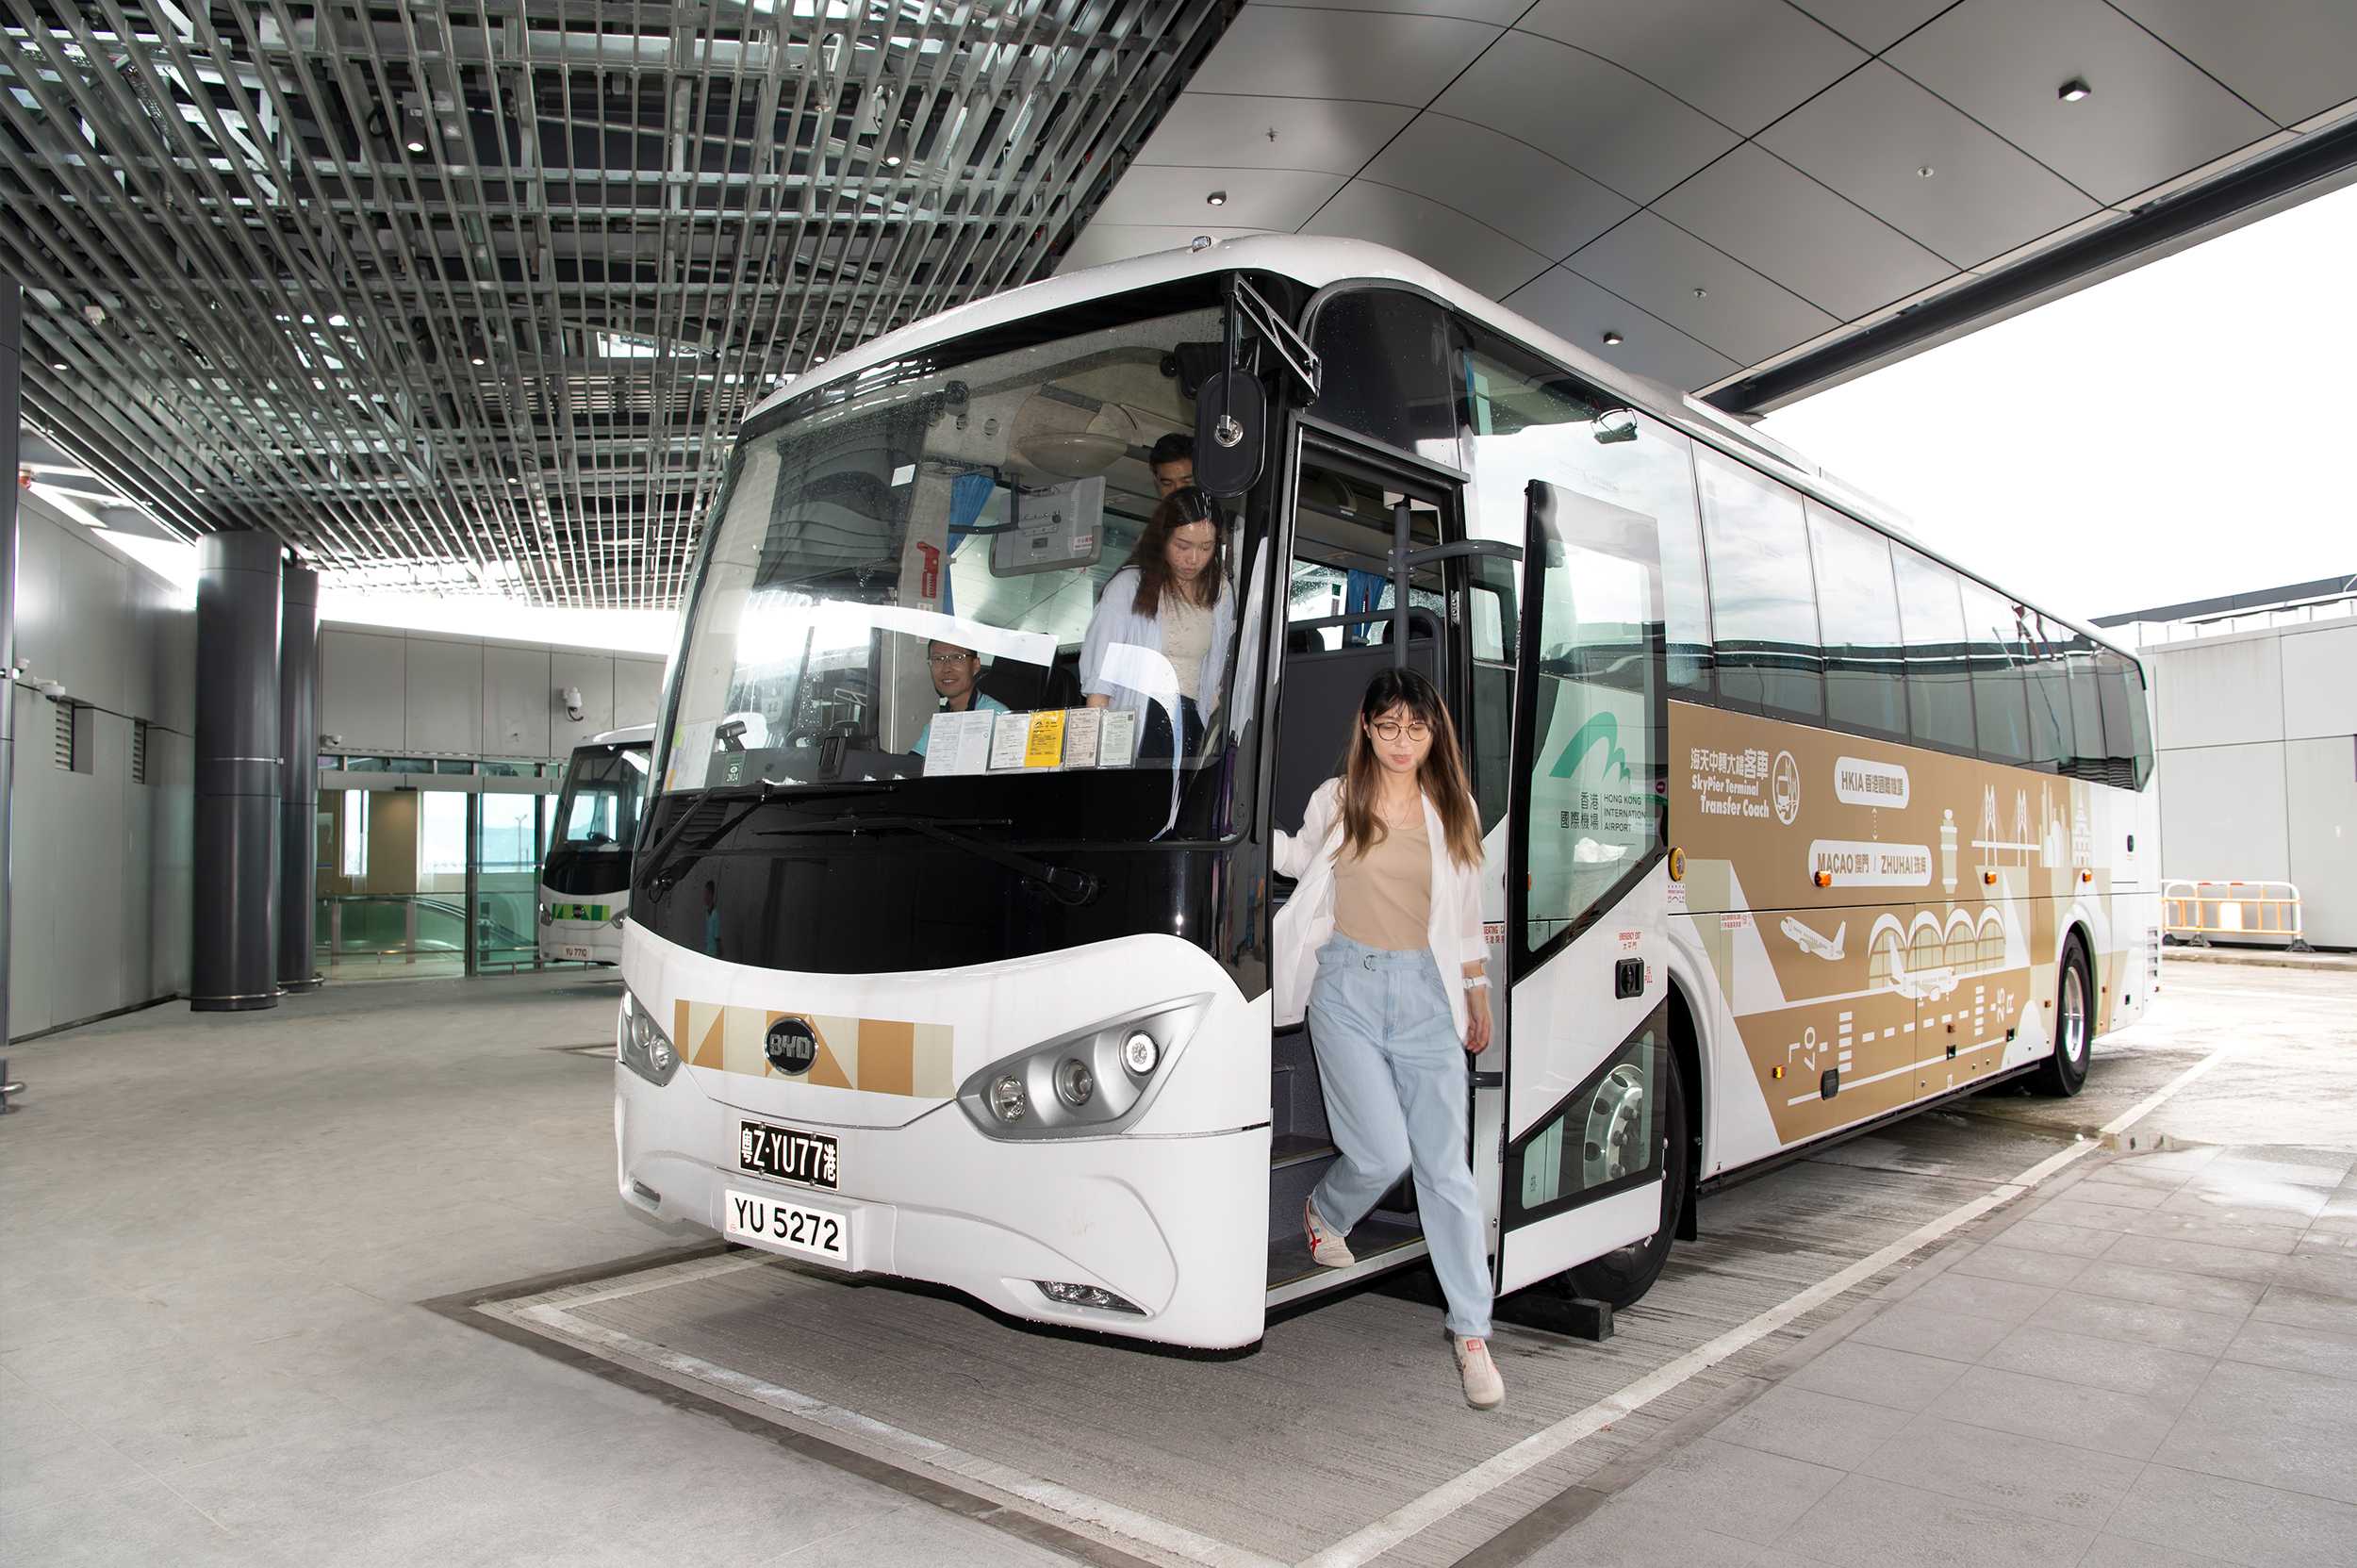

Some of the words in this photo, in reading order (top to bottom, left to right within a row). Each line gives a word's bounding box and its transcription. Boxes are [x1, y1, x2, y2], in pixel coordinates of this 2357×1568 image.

[1691, 774, 1724, 795] SkyPier
[1725, 779, 1758, 797] Terminal
[1840, 770, 1864, 792] HKIA
[1604, 793, 1623, 804] HONG
[1624, 796, 1642, 806] KONG
[1700, 794, 1741, 816] Transfer
[1742, 799, 1770, 818] Coach
[1604, 822, 1631, 833] AIRPORT
[1817, 852, 1854, 874] MACAO
[1881, 855, 1913, 875] ZHUHAI
[769, 1033, 813, 1060] BYD
[734, 1197, 765, 1233] YU
[773, 1206, 839, 1252] 5272
